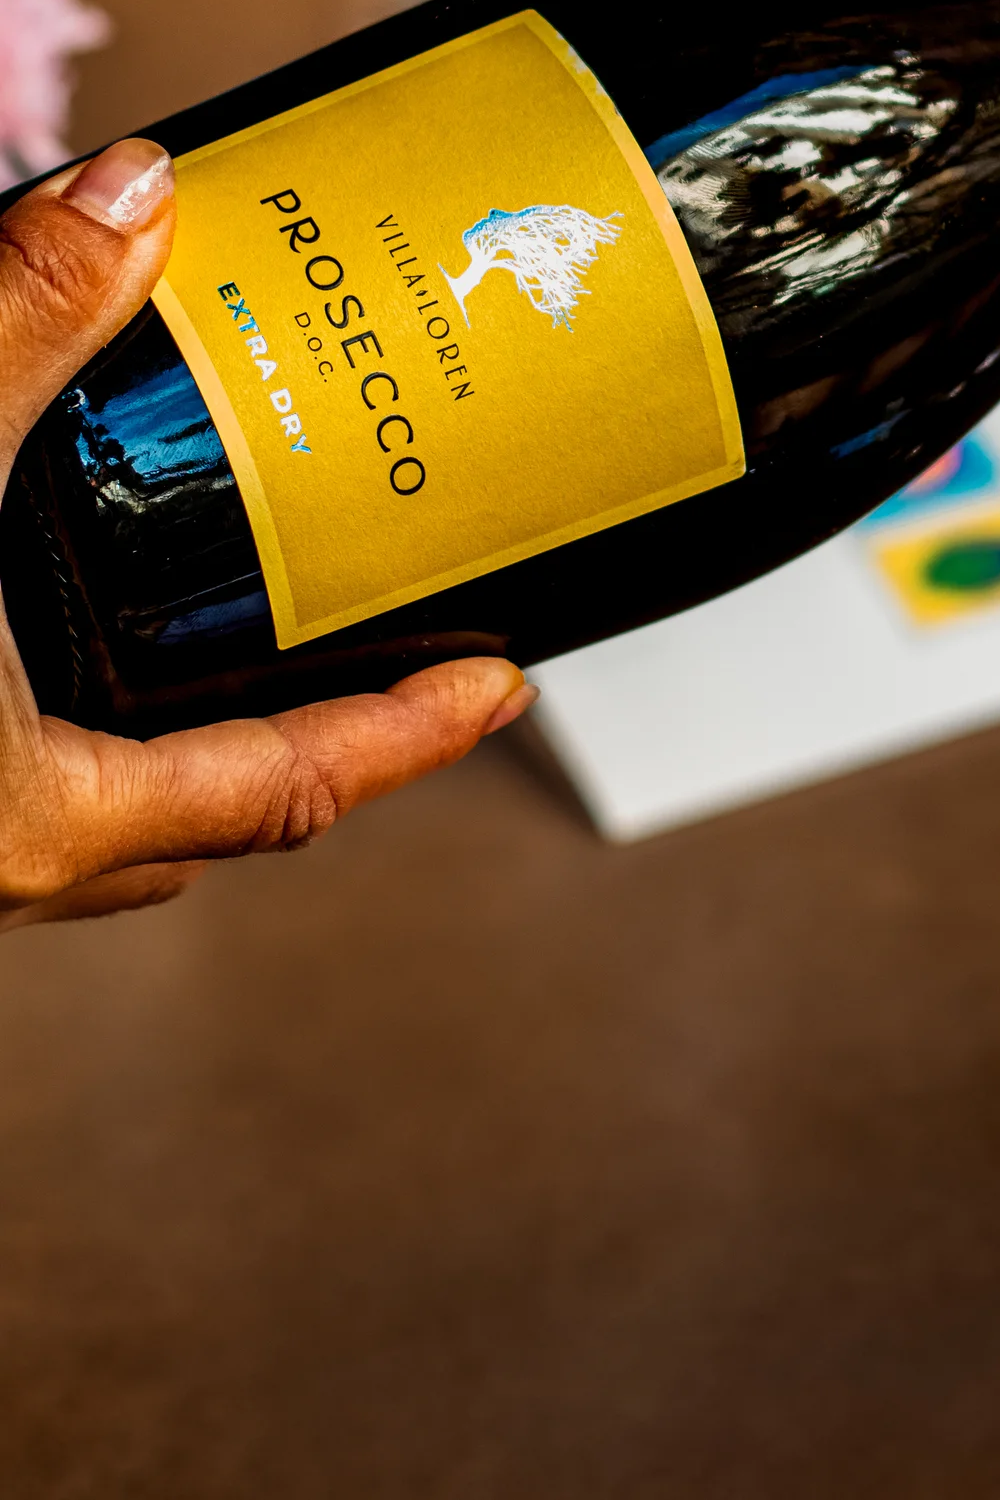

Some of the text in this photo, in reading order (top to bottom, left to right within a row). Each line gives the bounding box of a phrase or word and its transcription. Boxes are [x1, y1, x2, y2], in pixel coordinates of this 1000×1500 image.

[216, 281, 312, 454] EXTRA DRY
[259, 188, 427, 496] PROSECCO
[294, 311, 334, 383] D.O.C.
[375, 214, 475, 402] VILLA LOREN
